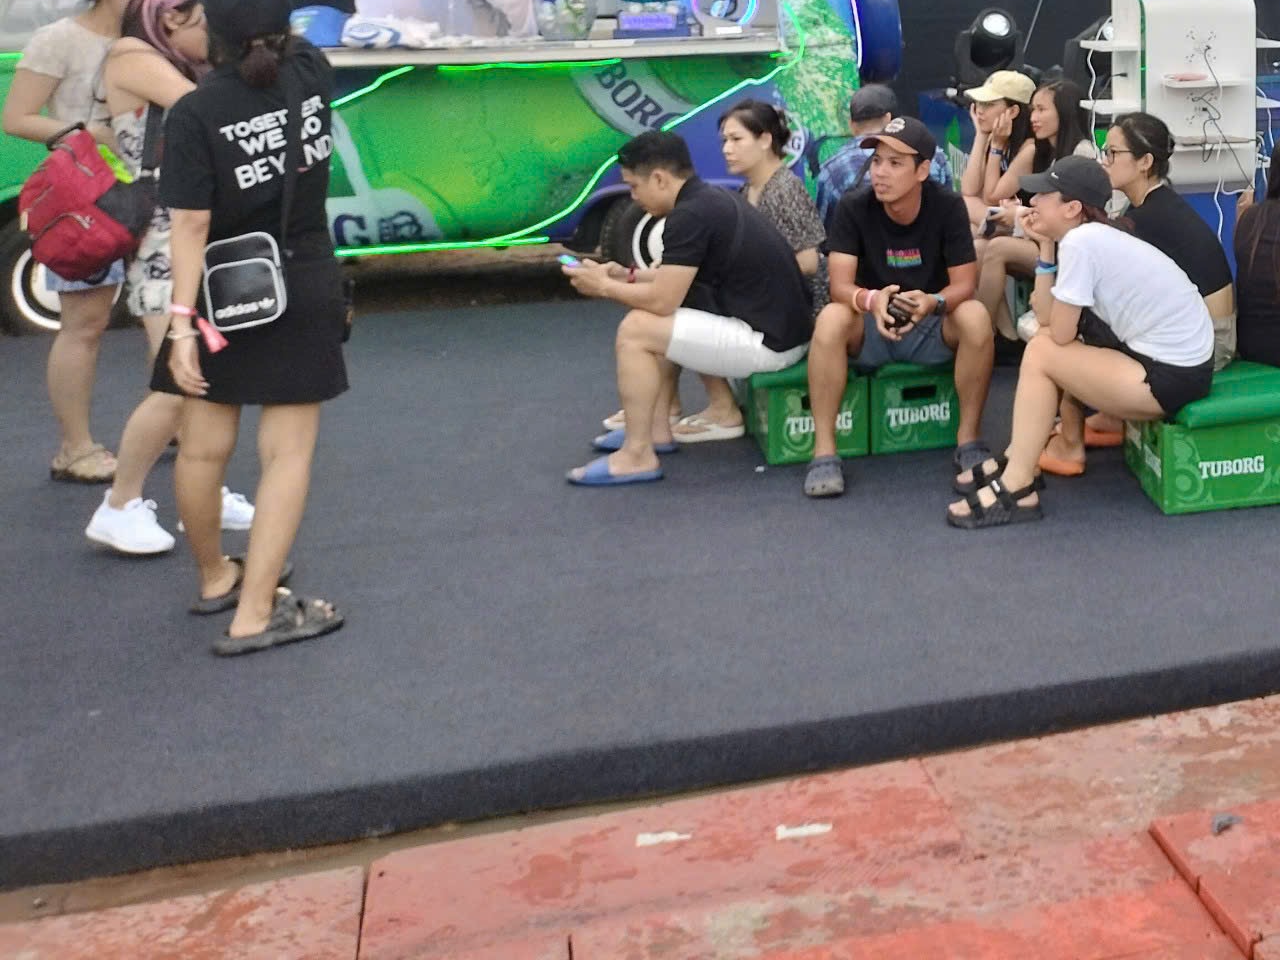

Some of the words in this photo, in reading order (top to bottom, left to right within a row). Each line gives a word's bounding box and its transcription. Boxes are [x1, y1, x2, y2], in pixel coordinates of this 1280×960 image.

[594, 61, 684, 130] BOR
[220, 95, 325, 142] TOGETER
[238, 127, 287, 156] WE
[301, 116, 322, 140] O
[234, 134, 334, 190] BEYND
[786, 411, 853, 436] TURG
[887, 401, 951, 428] TUBORG
[1199, 455, 1265, 479] TUBORG
